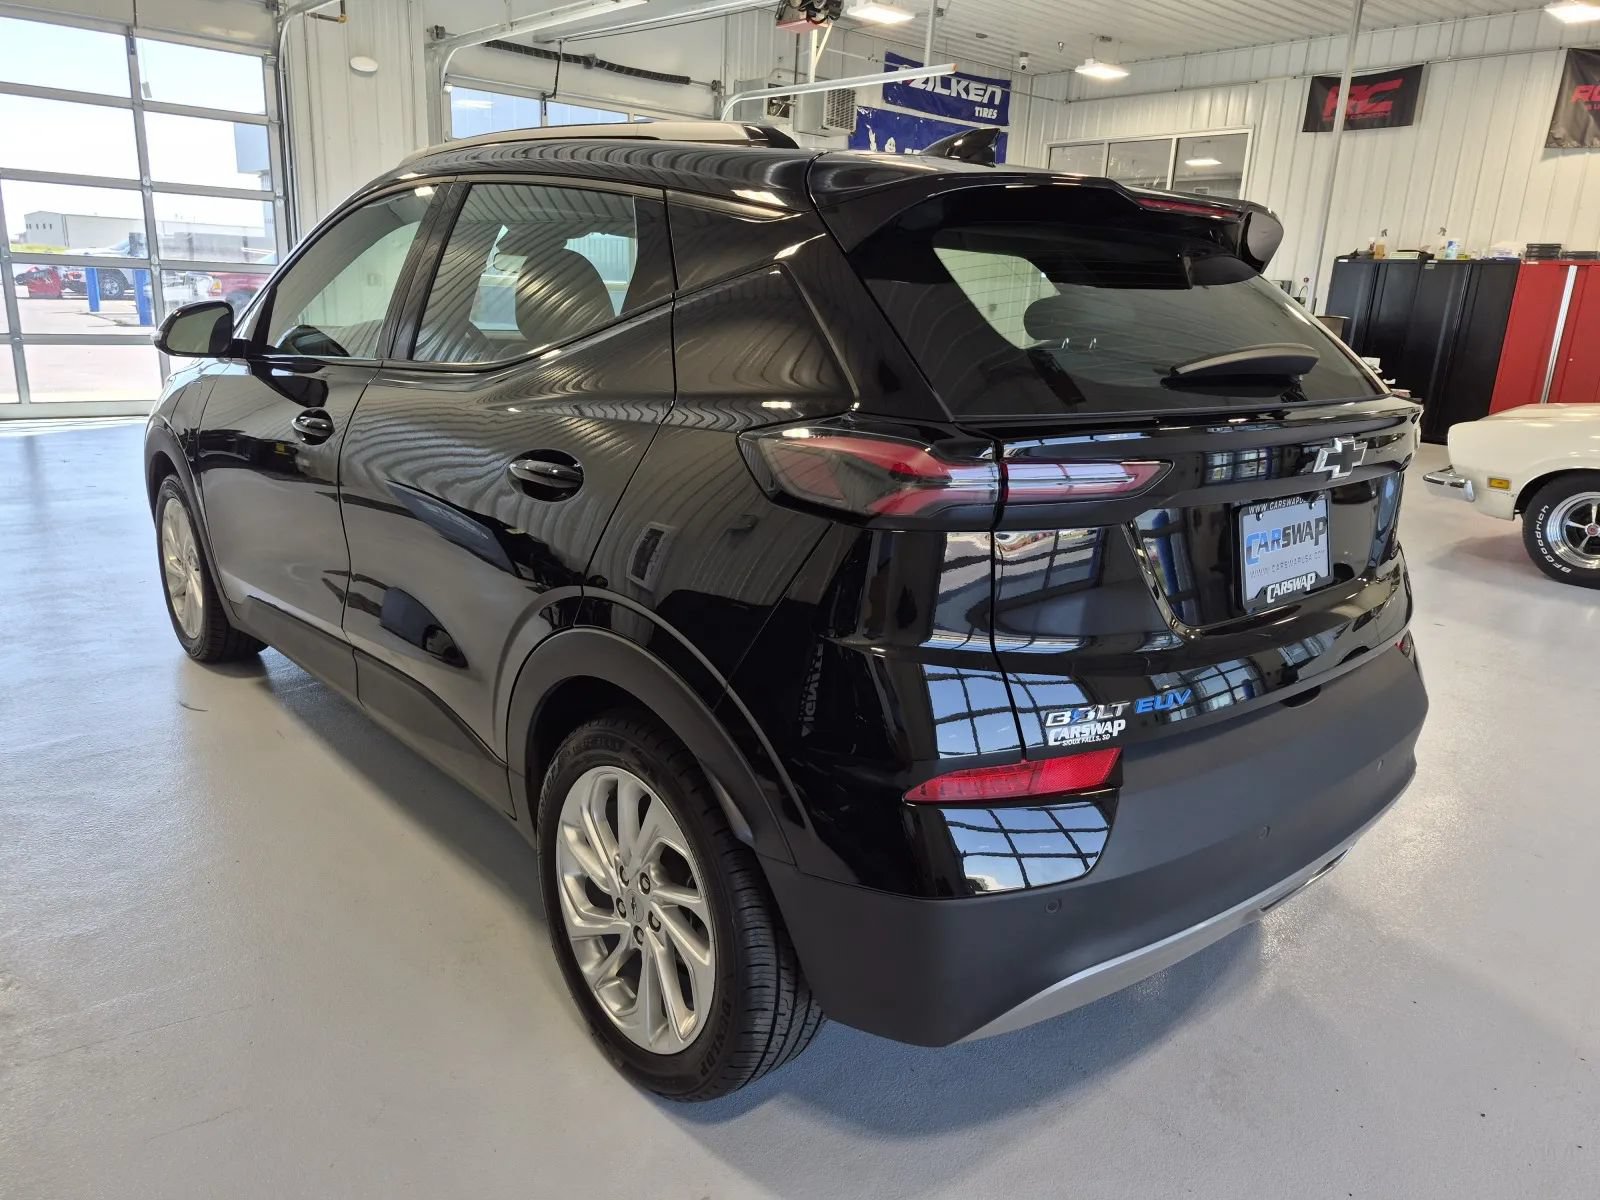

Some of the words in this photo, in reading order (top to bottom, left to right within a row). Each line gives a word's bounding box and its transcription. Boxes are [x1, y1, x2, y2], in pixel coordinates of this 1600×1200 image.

[974, 106, 998, 119] TIRES
[1245, 516, 1328, 566] CARSWAP
[1266, 572, 1316, 604] CARSWAP
[1045, 701, 1131, 727] BOLT
[1135, 689, 1192, 714] EUV
[1048, 719, 1126, 746] CARSWAP
[1062, 738, 1081, 747] SIOUX
[1102, 733, 1111, 741] SD
